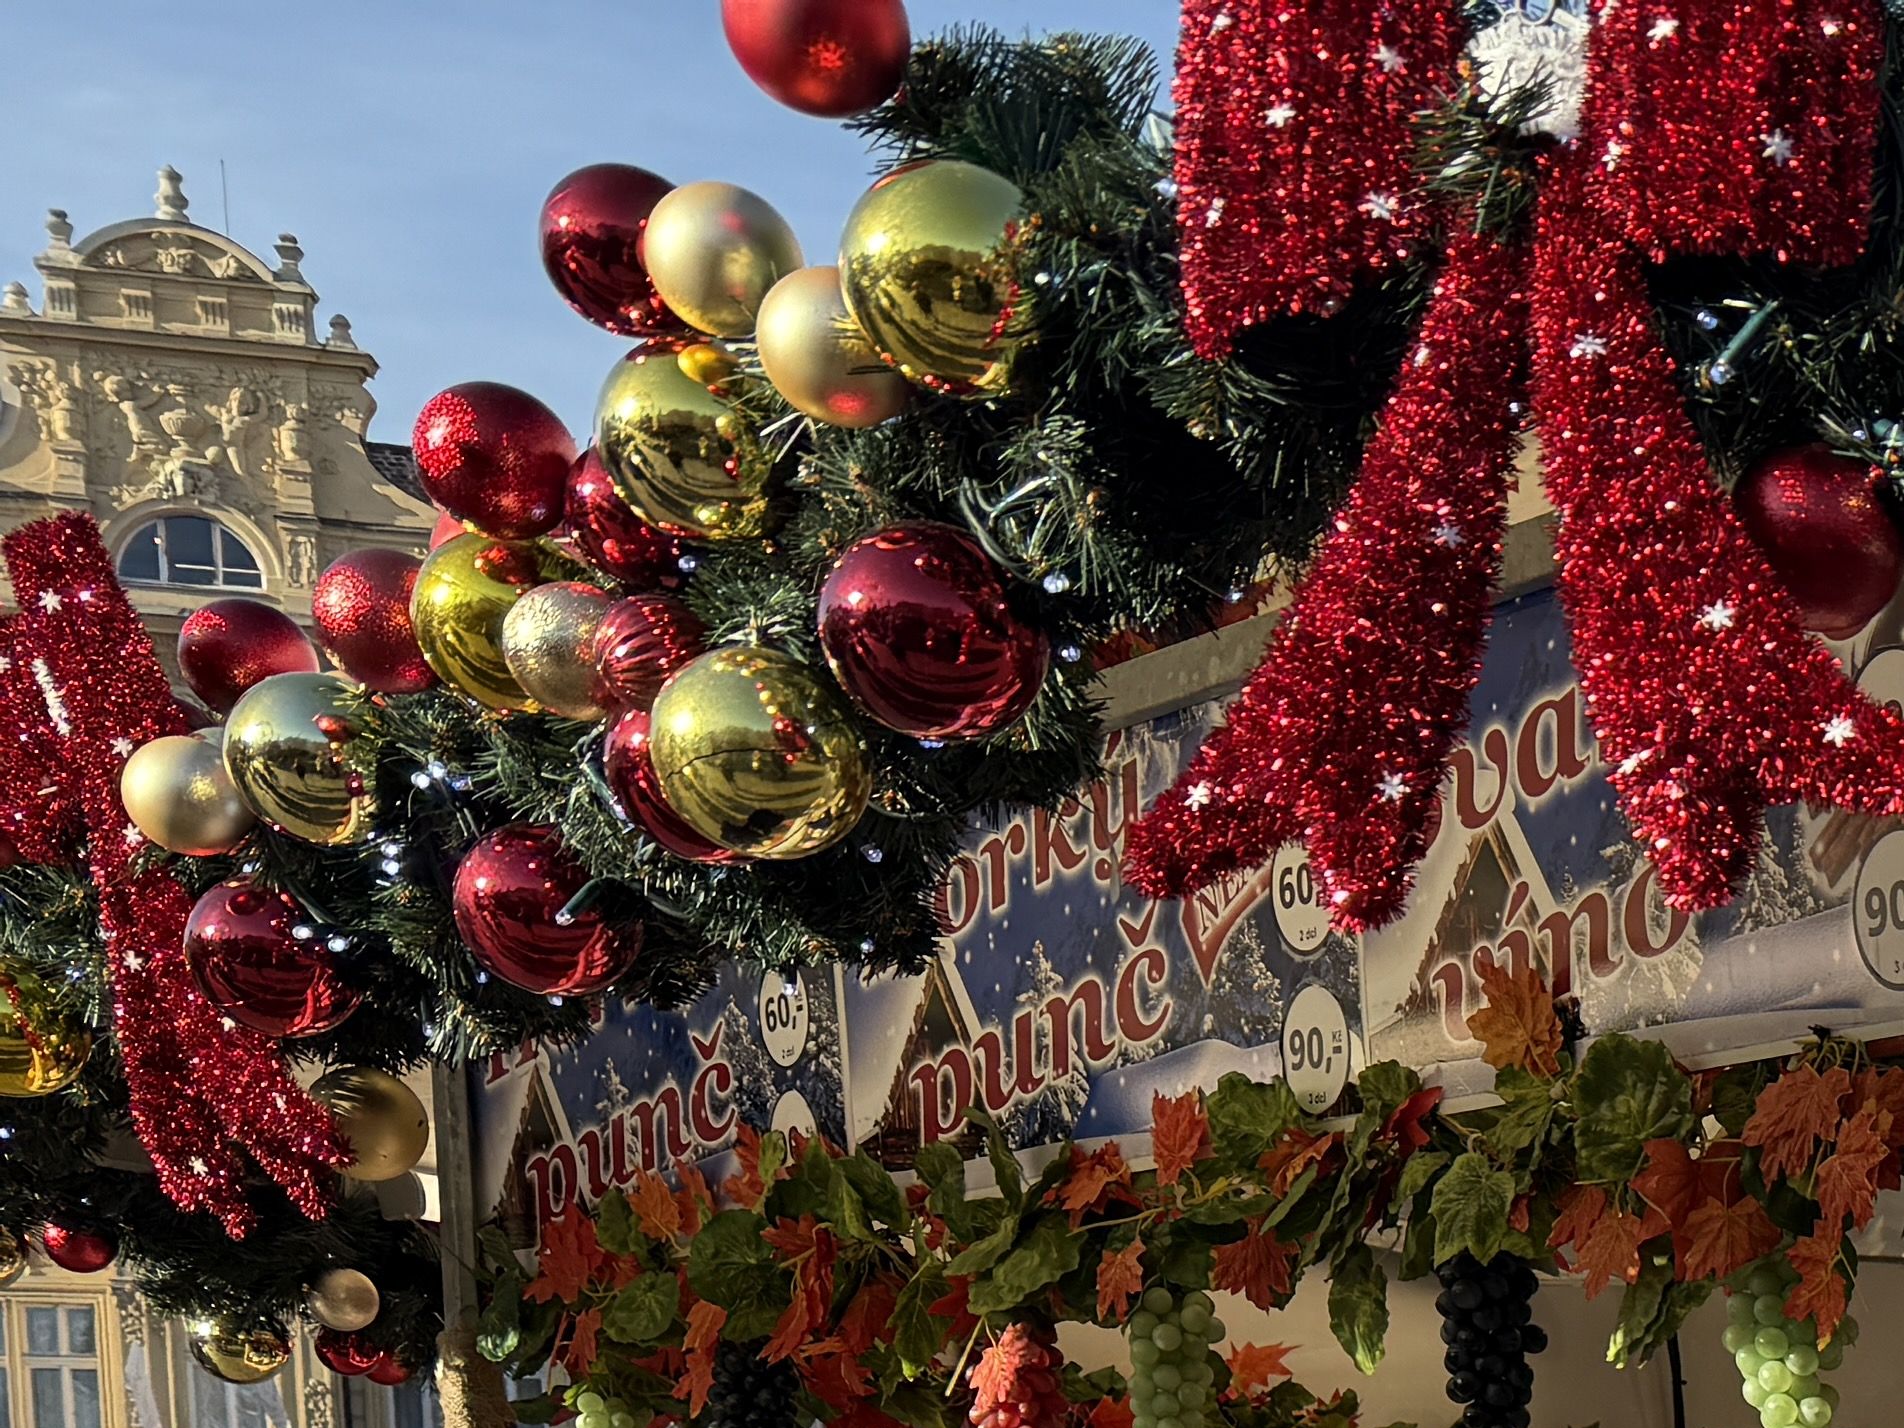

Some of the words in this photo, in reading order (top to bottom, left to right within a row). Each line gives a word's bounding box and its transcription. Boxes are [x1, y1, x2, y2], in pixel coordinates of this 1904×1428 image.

[938, 732, 1140, 935] orký
[527, 1022, 737, 1220] punč
[910, 916, 1169, 1146] punč
